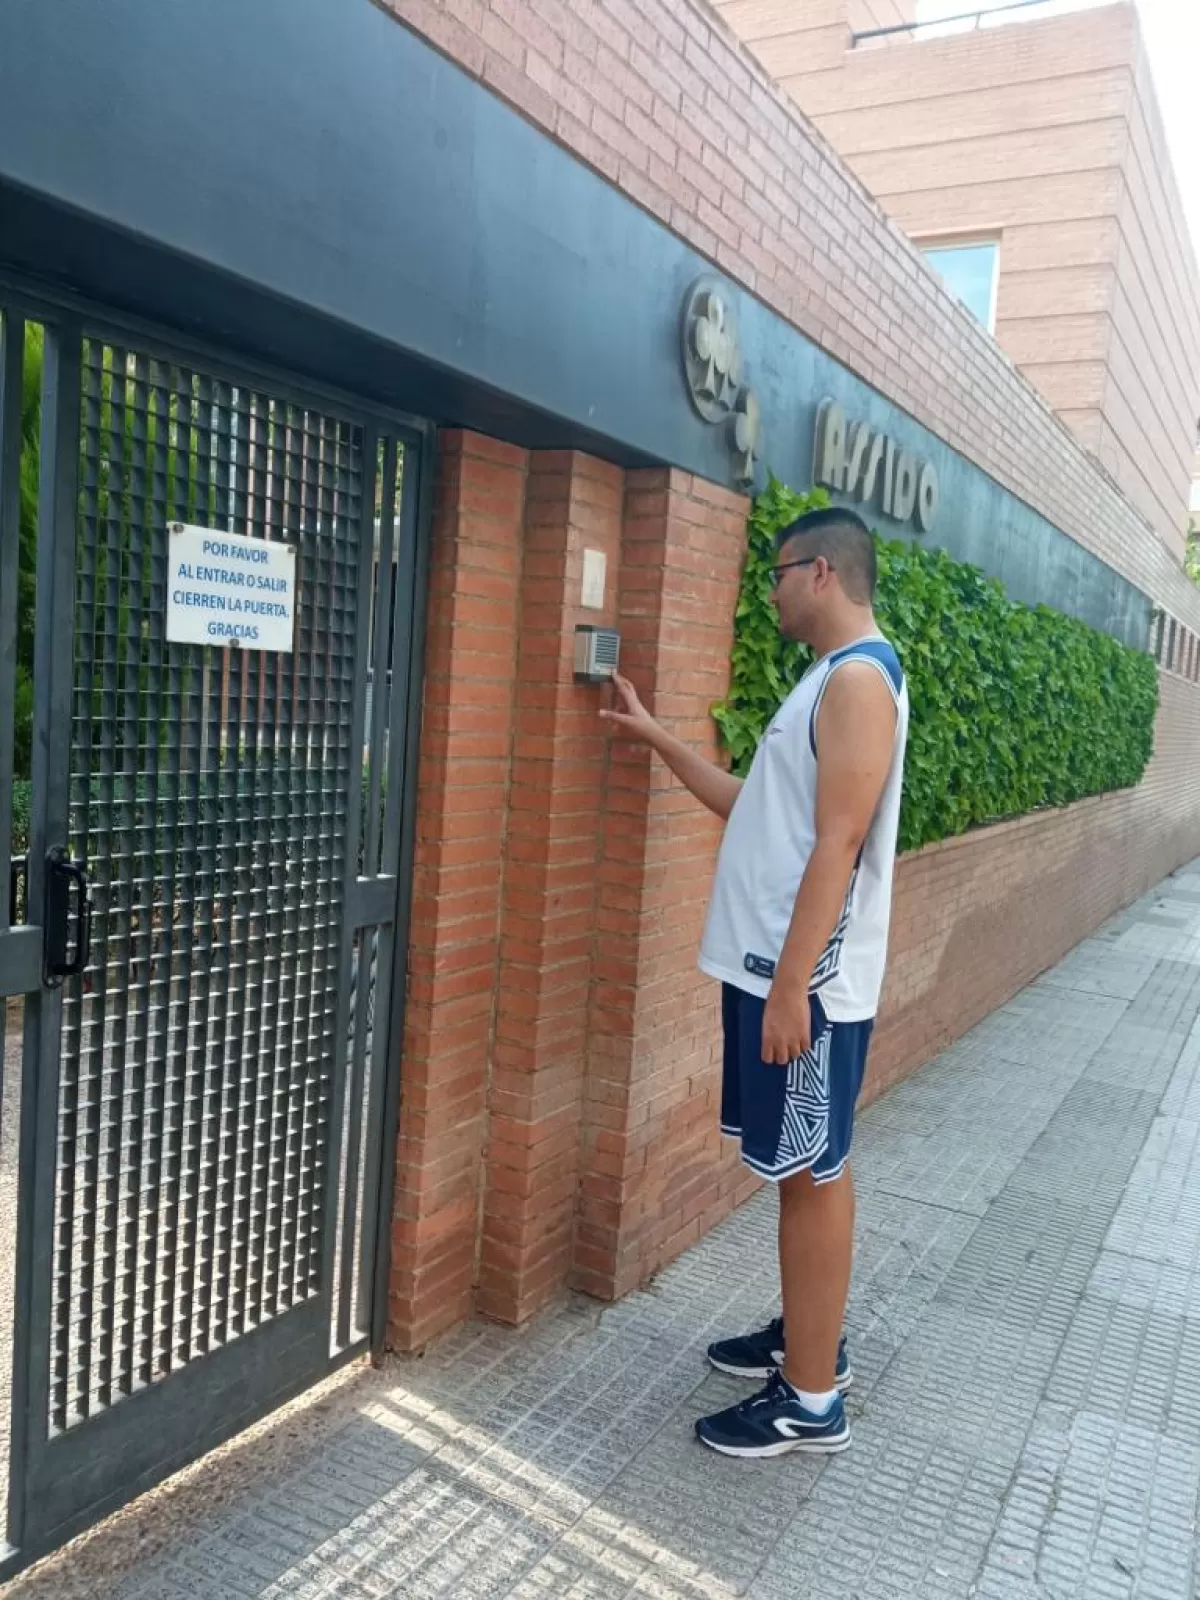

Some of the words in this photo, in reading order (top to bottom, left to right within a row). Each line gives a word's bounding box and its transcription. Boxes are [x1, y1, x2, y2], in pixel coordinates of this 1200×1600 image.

[202, 540, 229, 557] POR
[230, 545, 269, 564] FAVOR
[178, 563, 194, 579] AL
[196, 566, 245, 587] ENTRAR
[246, 574, 254, 588] O
[256, 576, 287, 593] SALIR
[173, 590, 226, 610] CIERREN
[228, 597, 242, 612] LA
[207, 621, 259, 640] GRACIAS
